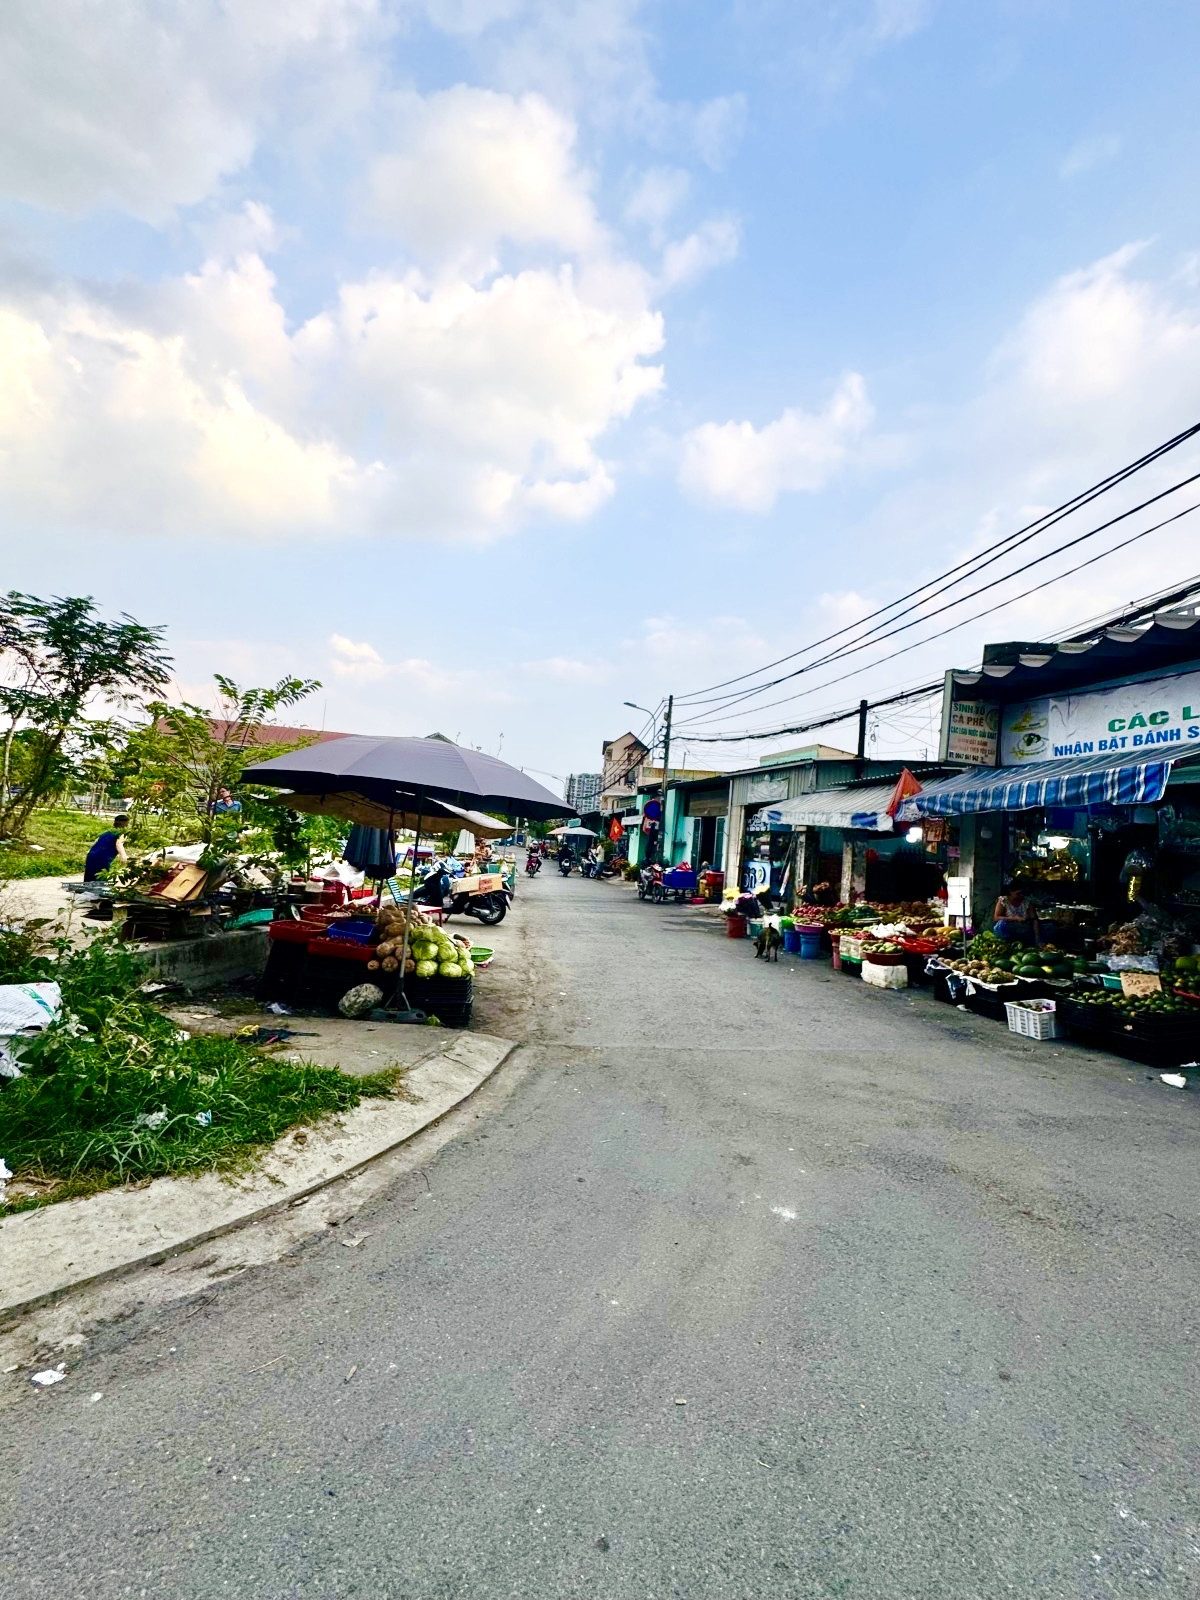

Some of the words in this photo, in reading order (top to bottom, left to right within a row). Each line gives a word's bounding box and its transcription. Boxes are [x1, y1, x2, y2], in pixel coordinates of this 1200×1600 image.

[953, 703, 974, 713] SINH
[1108, 712, 1170, 733] CÁC
[1054, 741, 1094, 757] NHẬN
[1133, 728, 1181, 747] BÁNH
